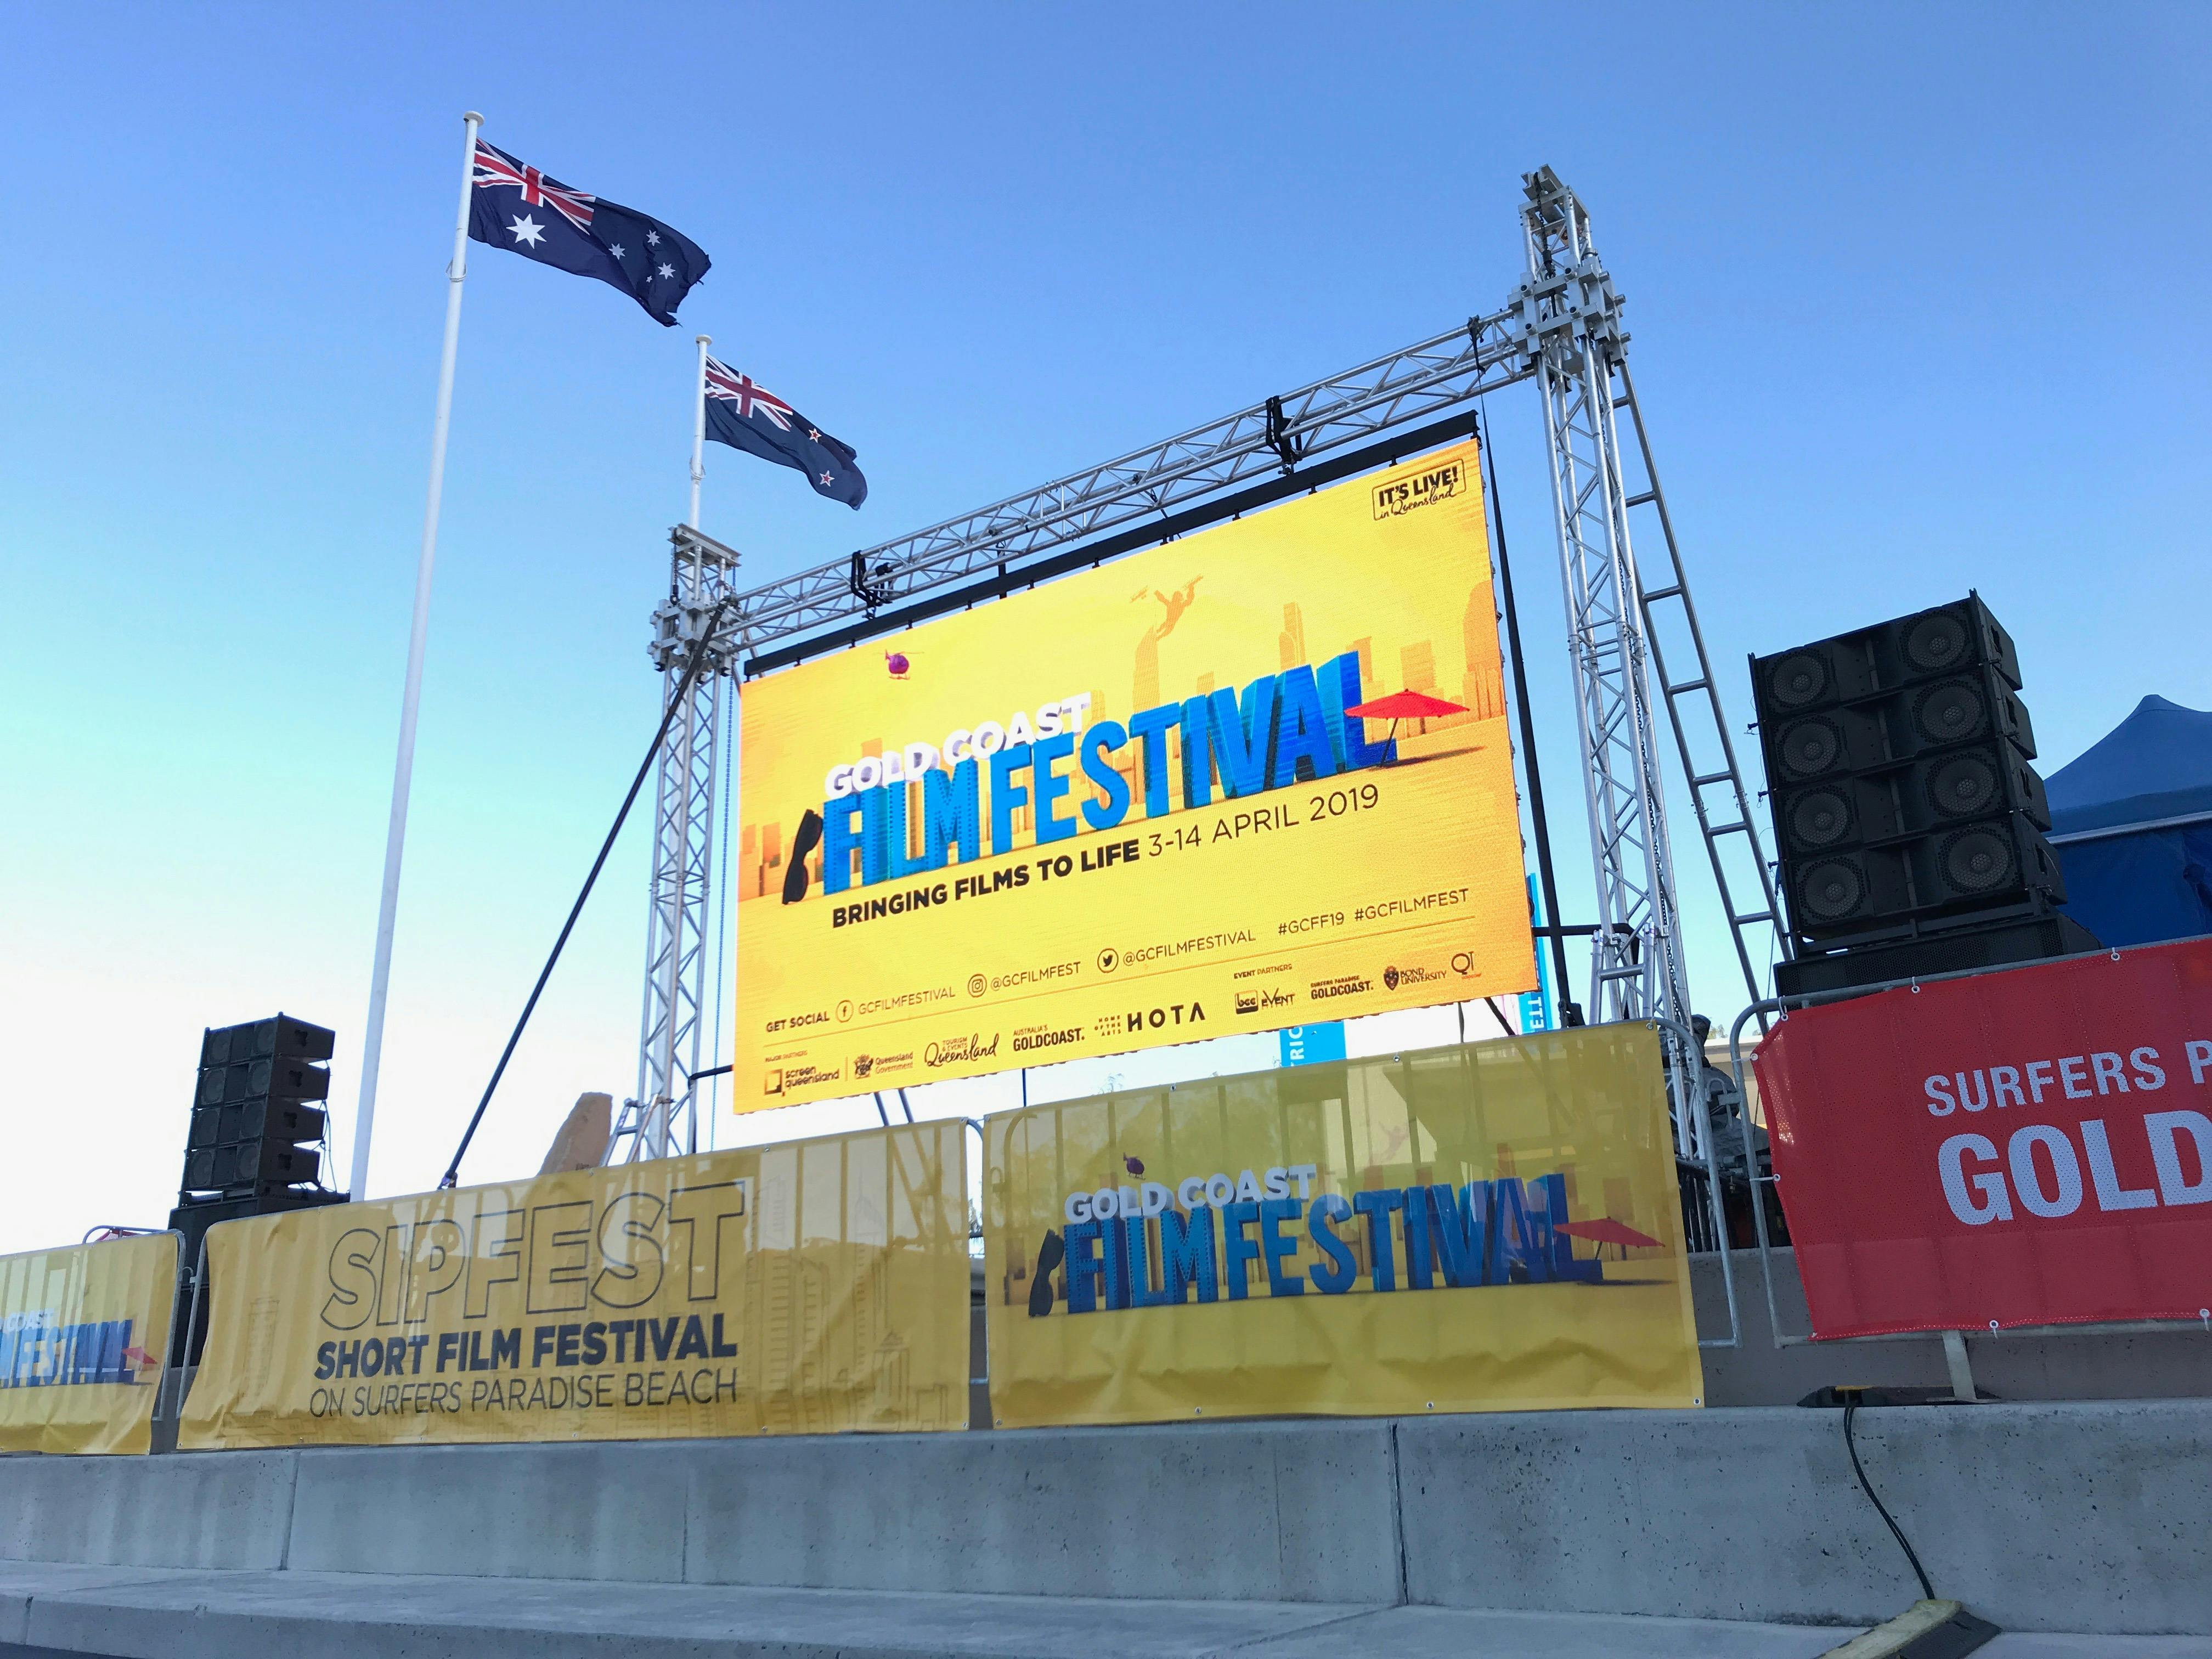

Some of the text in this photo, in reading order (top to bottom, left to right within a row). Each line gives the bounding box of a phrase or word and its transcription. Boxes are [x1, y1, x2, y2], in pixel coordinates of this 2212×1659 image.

[1379, 466, 1459, 507] IT'S LIVE!
[1380, 482, 1457, 520] in Queensland
[825, 691, 1091, 800] GOLD COAST
[832, 783, 1379, 928] BRINGING FILMS TO LIFE 3-14 APRIL 2019
[766, 1019, 787, 1032] GET
[789, 1011, 830, 1029] SOCIAL
[858, 986, 956, 1015] GCFILMFESTIVAL
[990, 961, 1081, 991] @GCFILMFEST
[1123, 928, 1256, 966] @GCFILMFESTIVAL
[1278, 912, 1345, 935] #GCFF19
[1353, 888, 1470, 922] #GCFILMFEST
[1234, 963, 1293, 979] EVENT PARTNERS
[1400, 967, 1425, 978] BOND
[1401, 970, 1447, 985] UNIVERSITY
[1013, 1024, 1048, 1036] AUSTRALIA'S
[1098, 1015, 1121, 1023] HOME
[1127, 1002, 1206, 1032] HOTA
[876, 1051, 913, 1065] Queensland
[924, 1032, 1000, 1067] Queensland
[786, 1066, 816, 1079] screen
[786, 1068, 840, 1088] queensland
[1924, 1046, 2166, 1117] SURFERS
[1938, 1110, 2212, 1226] GOLD
[1064, 1163, 1316, 1224] GOLD COAST
[320, 1180, 746, 1331] SIPFEST
[313, 1312, 737, 1381] SHORT FILM FESTIVAL
[309, 1367, 738, 1419] ON SURFERS PARADISE BEACH
